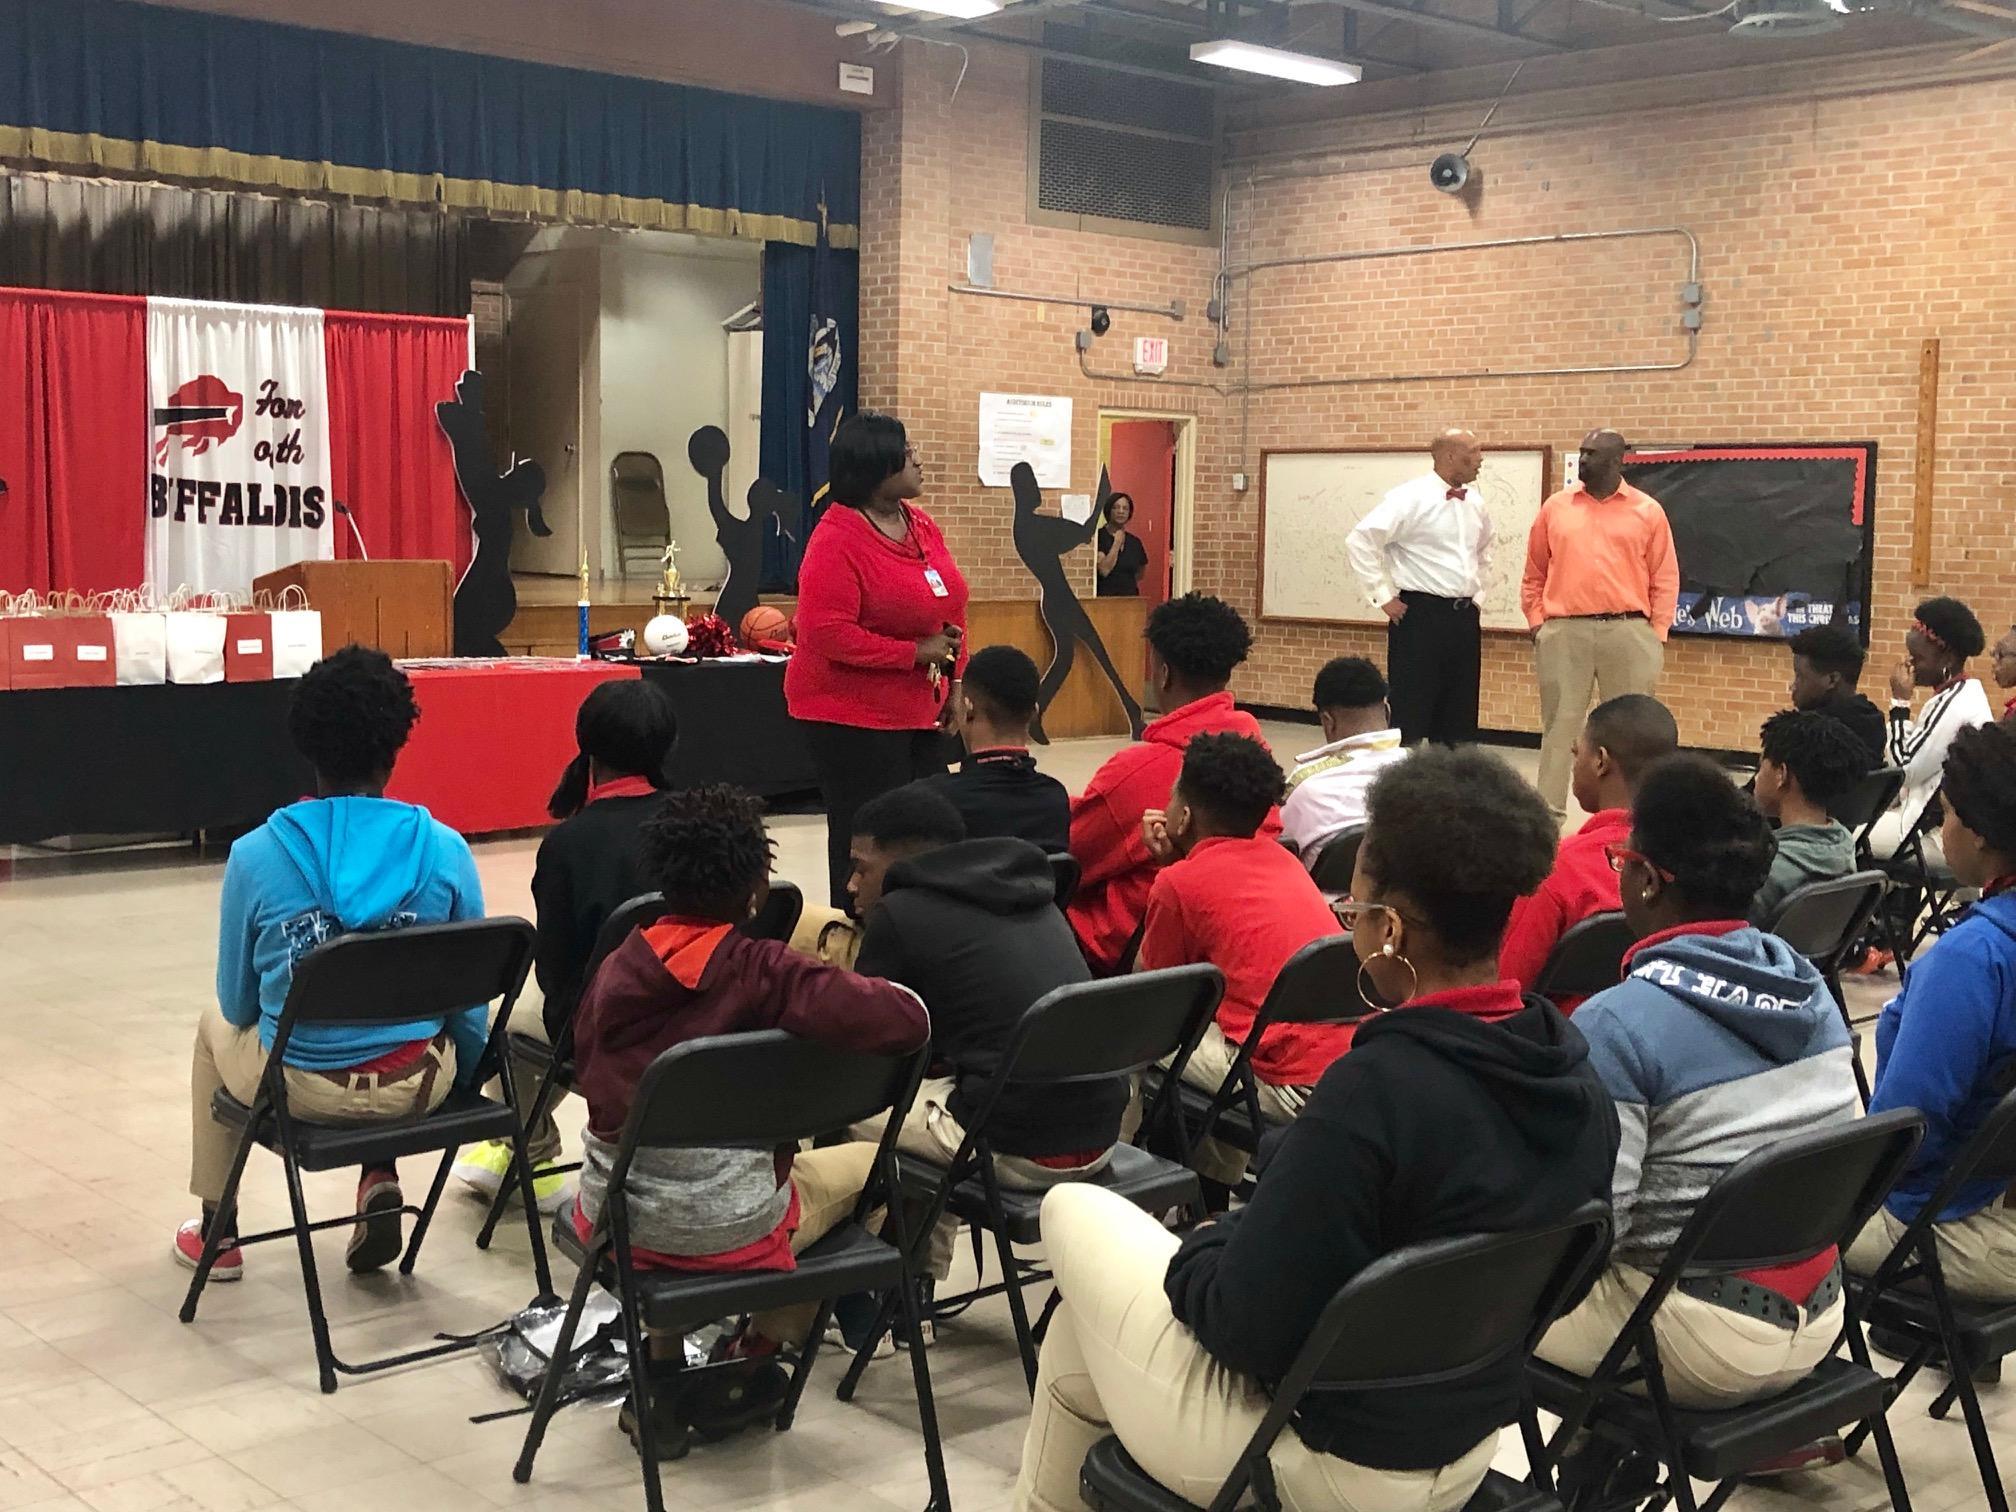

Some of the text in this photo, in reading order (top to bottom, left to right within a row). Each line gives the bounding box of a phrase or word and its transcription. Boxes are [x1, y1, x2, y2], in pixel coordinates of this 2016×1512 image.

[1142, 339, 1163, 363] EXIT
[1704, 596, 1743, 631] Web
[1787, 613, 1807, 624] THIS
